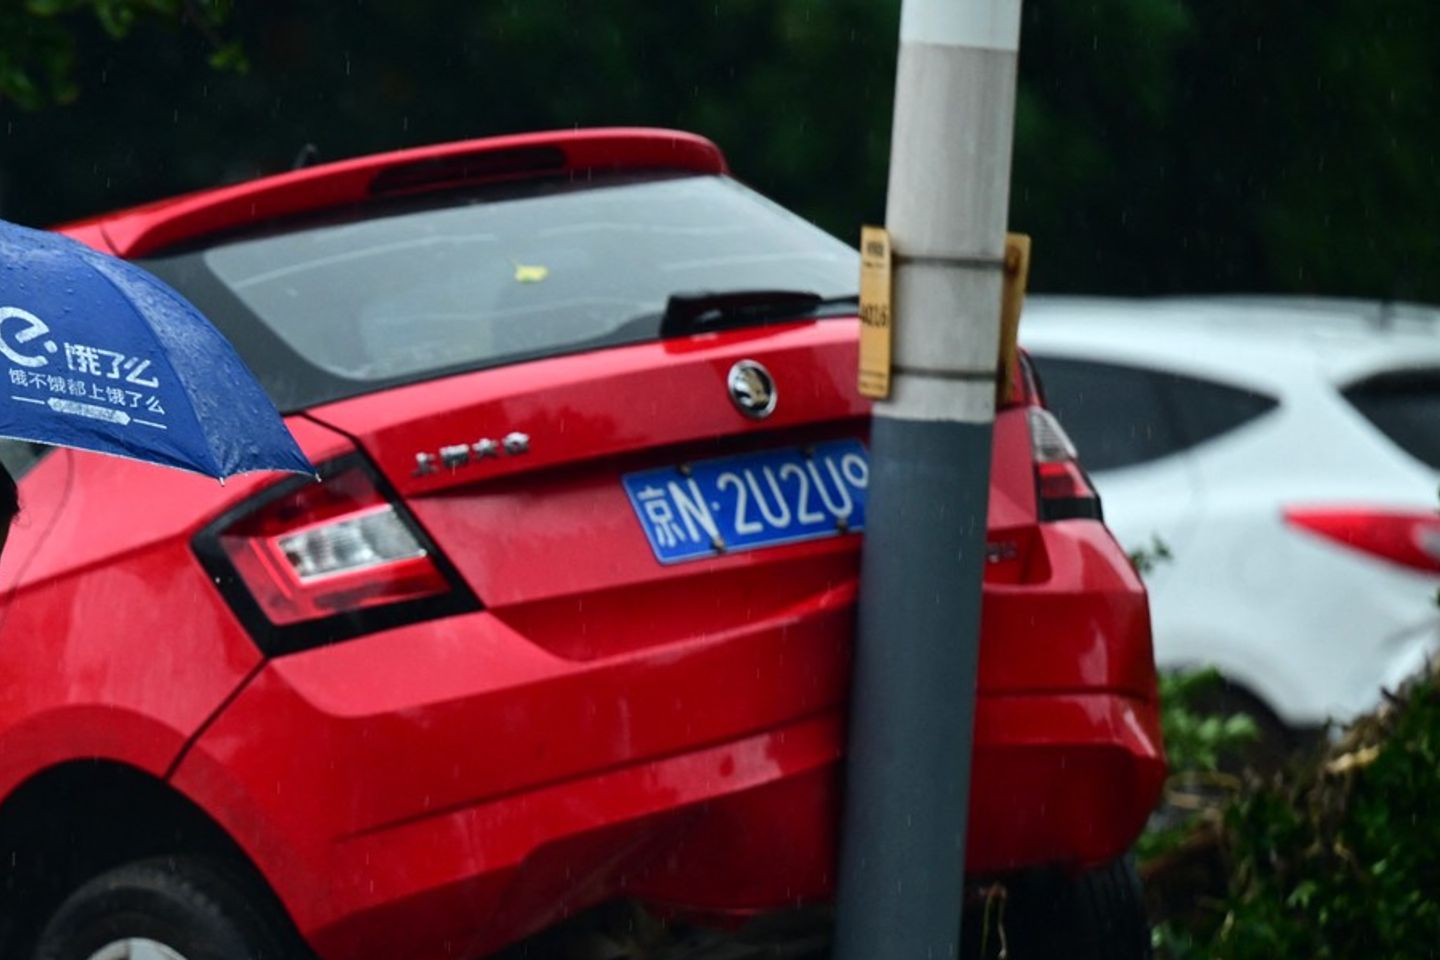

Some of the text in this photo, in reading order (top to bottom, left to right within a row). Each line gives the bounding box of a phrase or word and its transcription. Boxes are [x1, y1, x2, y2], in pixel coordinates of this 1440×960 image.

[64, 342, 159, 388] 饿了么
[8, 368, 165, 415] 饿不饿都上饿了么
